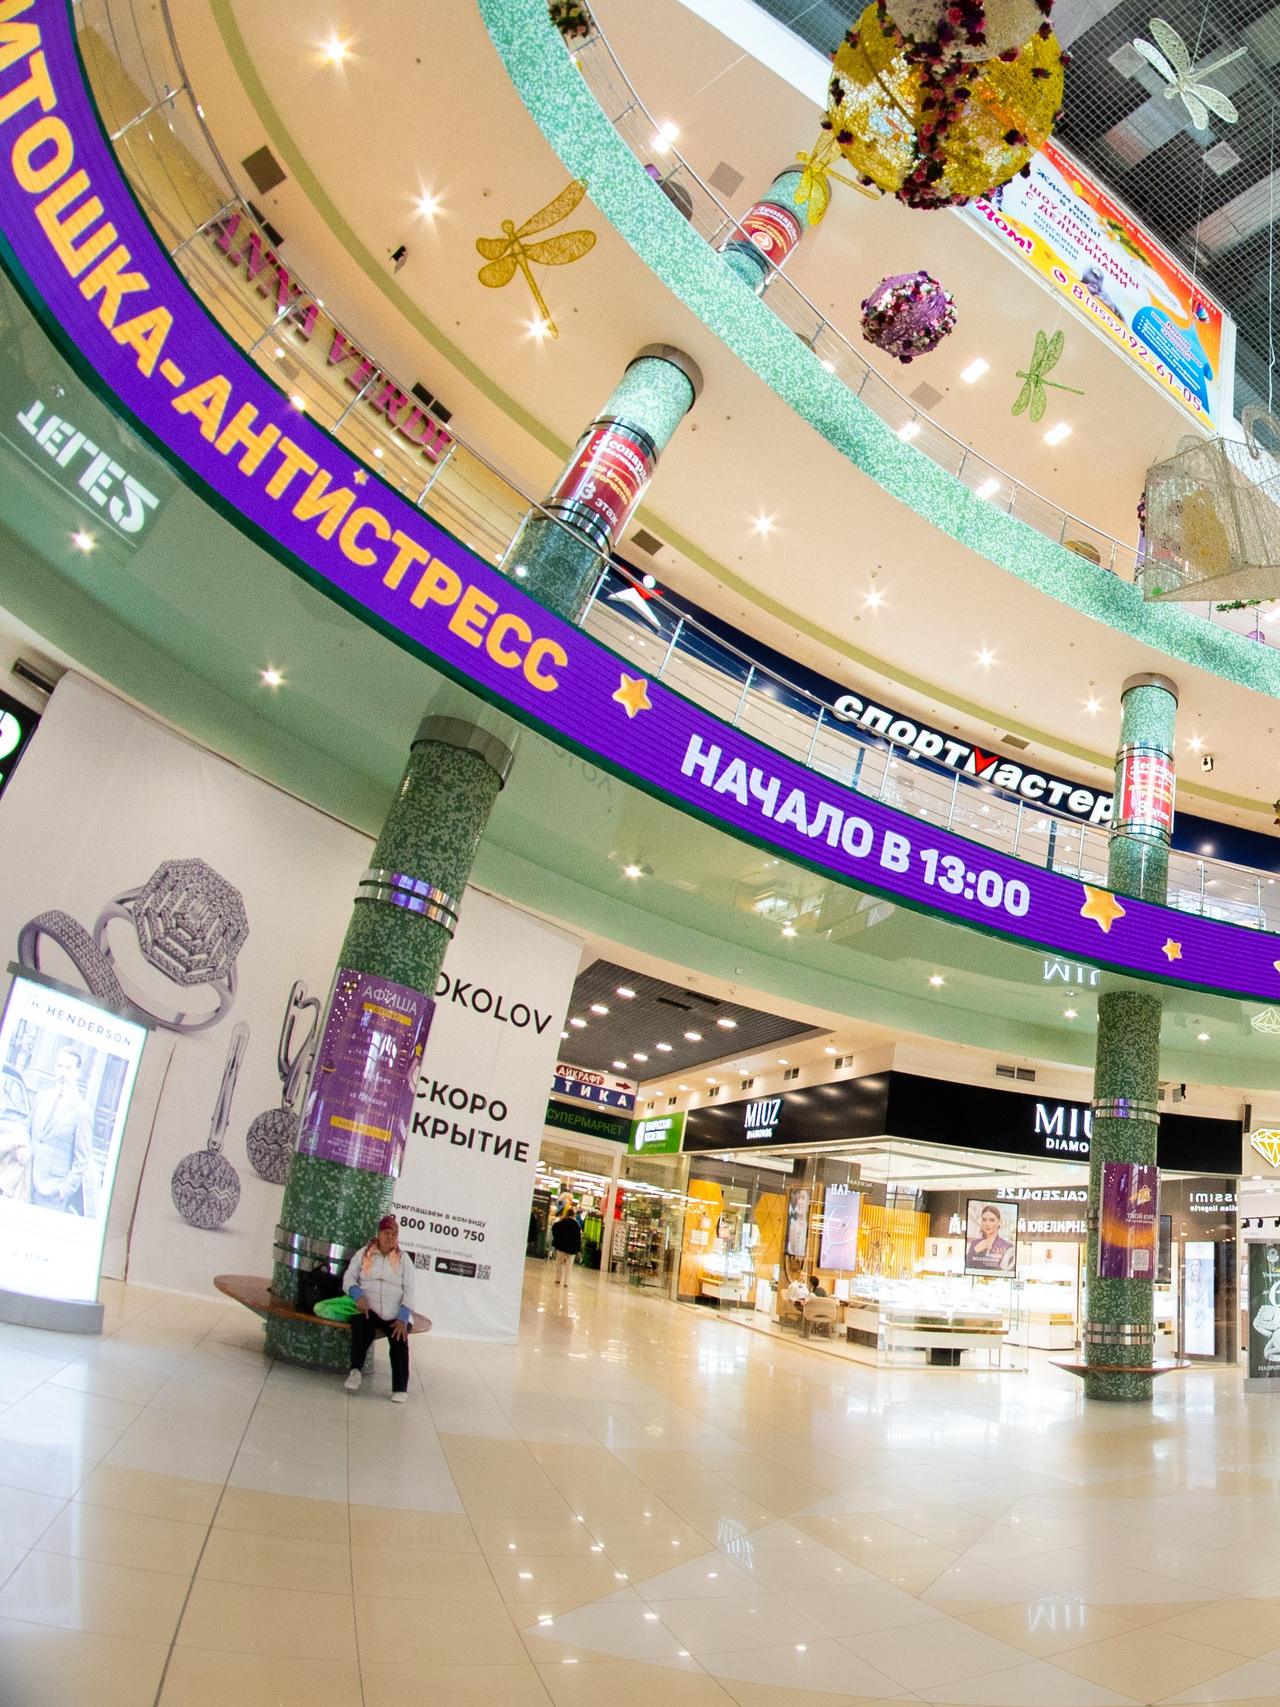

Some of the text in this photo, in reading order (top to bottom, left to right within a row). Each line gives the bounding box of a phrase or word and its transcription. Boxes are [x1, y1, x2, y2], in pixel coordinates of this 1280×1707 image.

[1034, 167, 1093, 224] Ждем вас
[976, 197, 1033, 254] ДОМ!
[1026, 181, 1140, 292] ШОУ-ПРОГРАММЫ
[1032, 210, 1080, 257] морскими
[1032, 218, 1078, 262] котиками
[1066, 205, 1101, 240] гости!
[1037, 202, 1129, 291] ДЕЛЬФИНАМИ
[204, 213, 455, 466] ANNA VERDI
[595, 497, 619, 527] этаж
[680, 733, 875, 859] НАЧАЛО
[879, 830, 911, 874] В
[919, 848, 1031, 918] 13:00
[362, 985, 418, 1016] АФИША
[436, 971, 553, 1036] OKOLOV
[46, 1004, 132, 1047] HENDERSON
[551, 1079, 627, 1107] ТИКА
[744, 1099, 782, 1128] MIUZ
[411, 1111, 531, 1164] КРЫТИЕ
[546, 1108, 623, 1136] СУПЕРМАРКЕТ
[1034, 1103, 1093, 1139] MIU
[1045, 1137, 1090, 1153] DIAMO
[391, 1201, 443, 1219] приглашаем
[452, 1214, 487, 1228] команду
[400, 1216, 426, 1231] 800
[429, 1222, 459, 1238] 1000
[463, 1229, 485, 1243] 750
